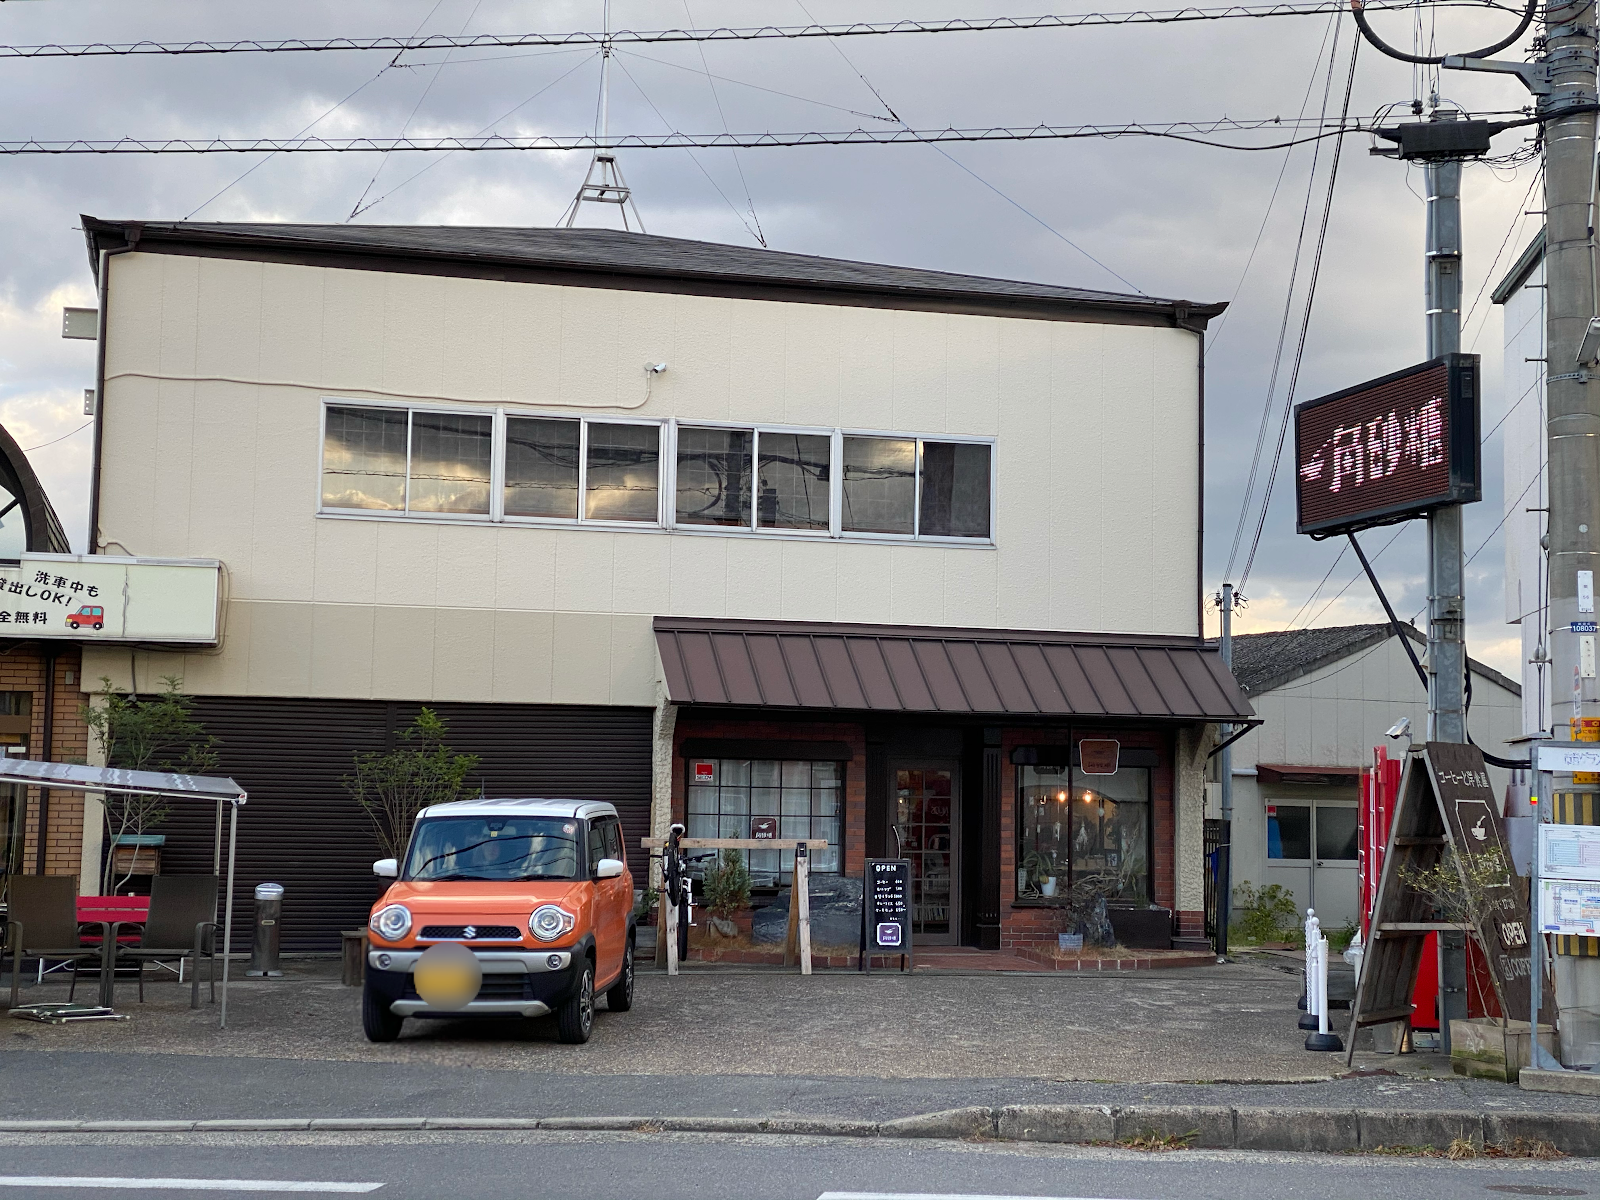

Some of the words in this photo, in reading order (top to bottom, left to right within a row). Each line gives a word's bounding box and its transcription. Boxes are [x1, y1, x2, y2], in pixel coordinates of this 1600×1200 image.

[1329, 396, 1442, 493] 角砂糖
[34, 570, 99, 598] 洗車中も
[0, 611, 48, 624] 全無料
[1438, 770, 1489, 788] コーヒーと洋食屋
[1501, 922, 1528, 946] OPEN
[1510, 957, 1532, 977] COFF
